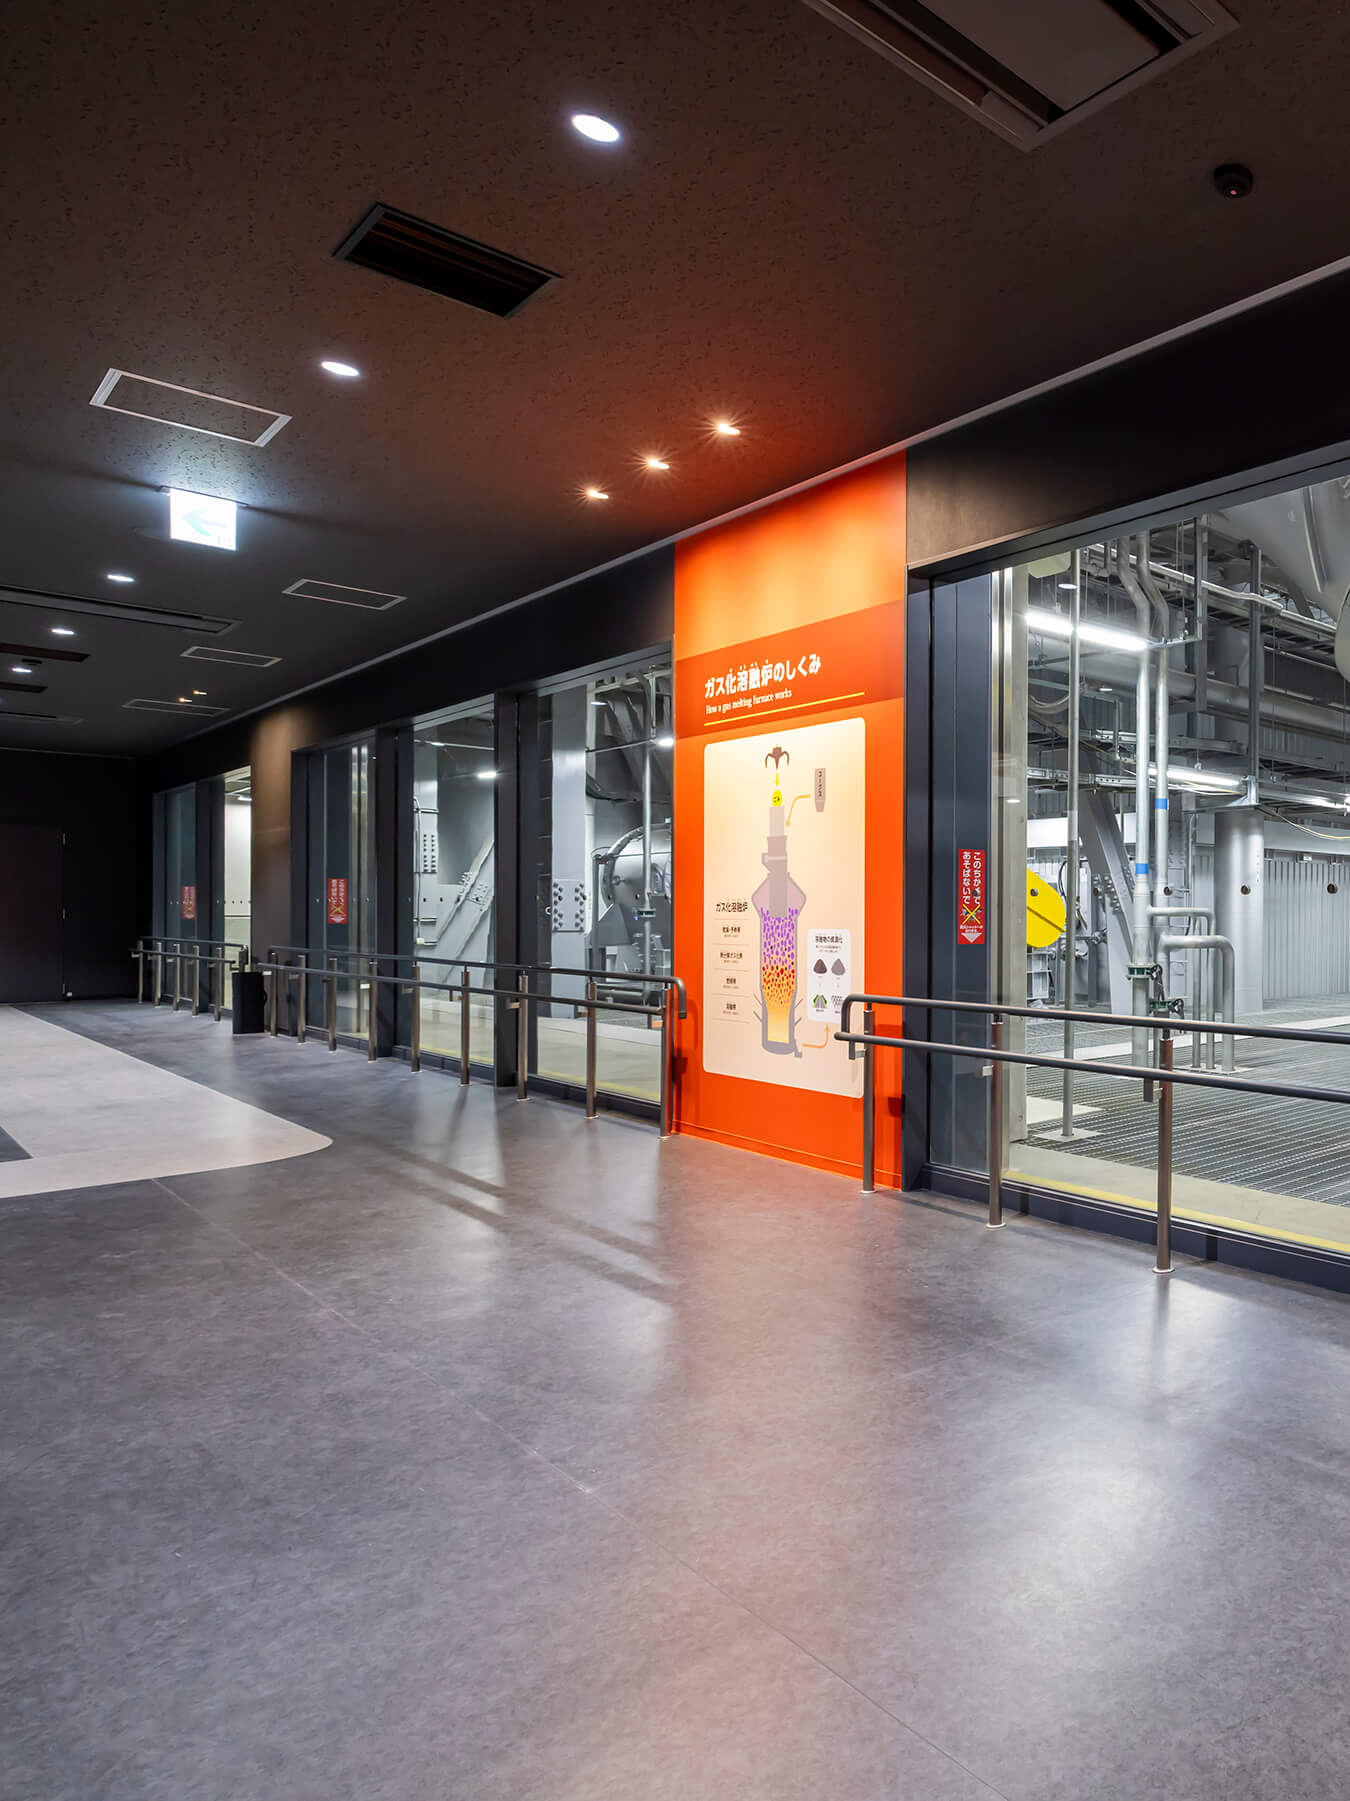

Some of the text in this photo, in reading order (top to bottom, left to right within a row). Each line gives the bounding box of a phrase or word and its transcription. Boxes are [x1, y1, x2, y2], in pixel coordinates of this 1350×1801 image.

[704, 653, 821, 698] ガス化溶融炉のしくみ
[706, 704, 717, 714] How
[722, 703, 731, 713] gas
[732, 698, 752, 708] melting
[753, 694, 774, 704] furnace
[775, 688, 792, 699] works
[962, 851, 971, 905] あそばないで
